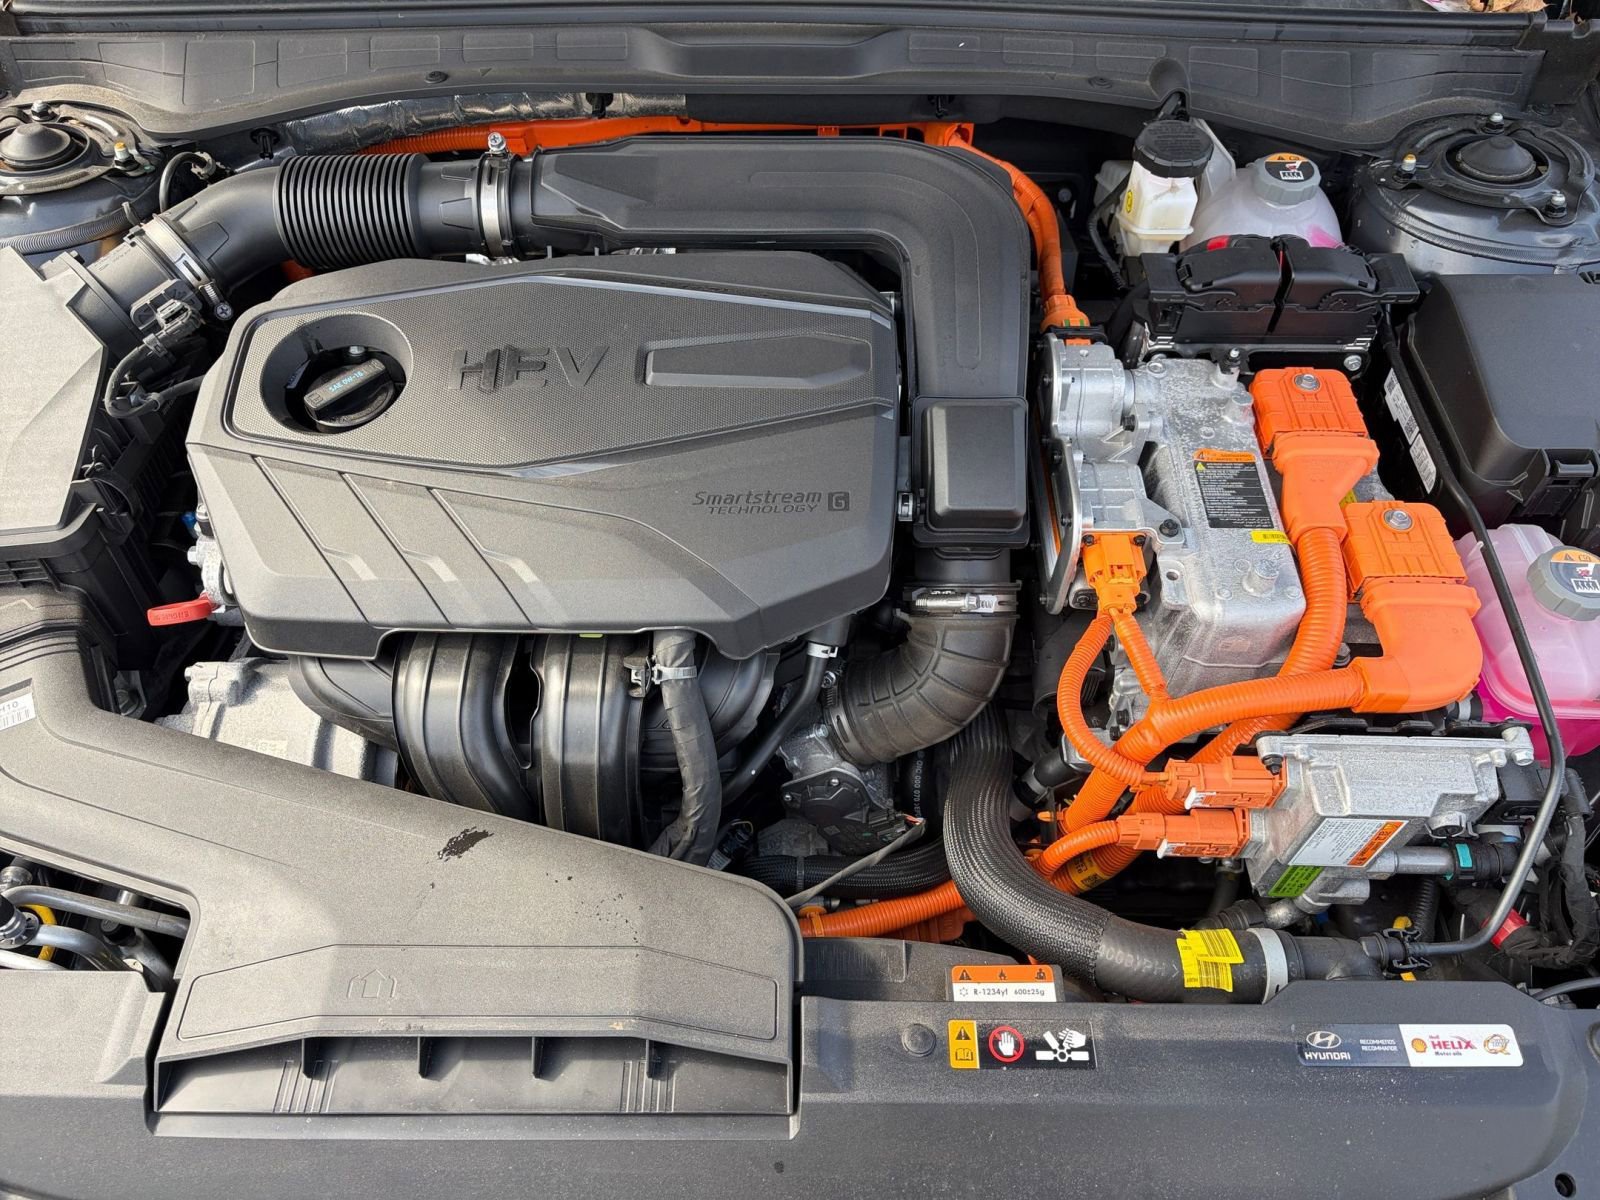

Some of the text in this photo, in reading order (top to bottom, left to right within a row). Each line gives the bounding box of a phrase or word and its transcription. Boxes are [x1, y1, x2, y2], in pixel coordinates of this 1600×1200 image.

[448, 346, 610, 391] HEV
[329, 381, 343, 392] SAE
[692, 490, 848, 511] Smartstream G
[708, 504, 818, 515] TECHNOLOGY
[1431, 1040, 1474, 1050] HELIX
[1304, 1051, 1351, 1060] HYUNDAI
